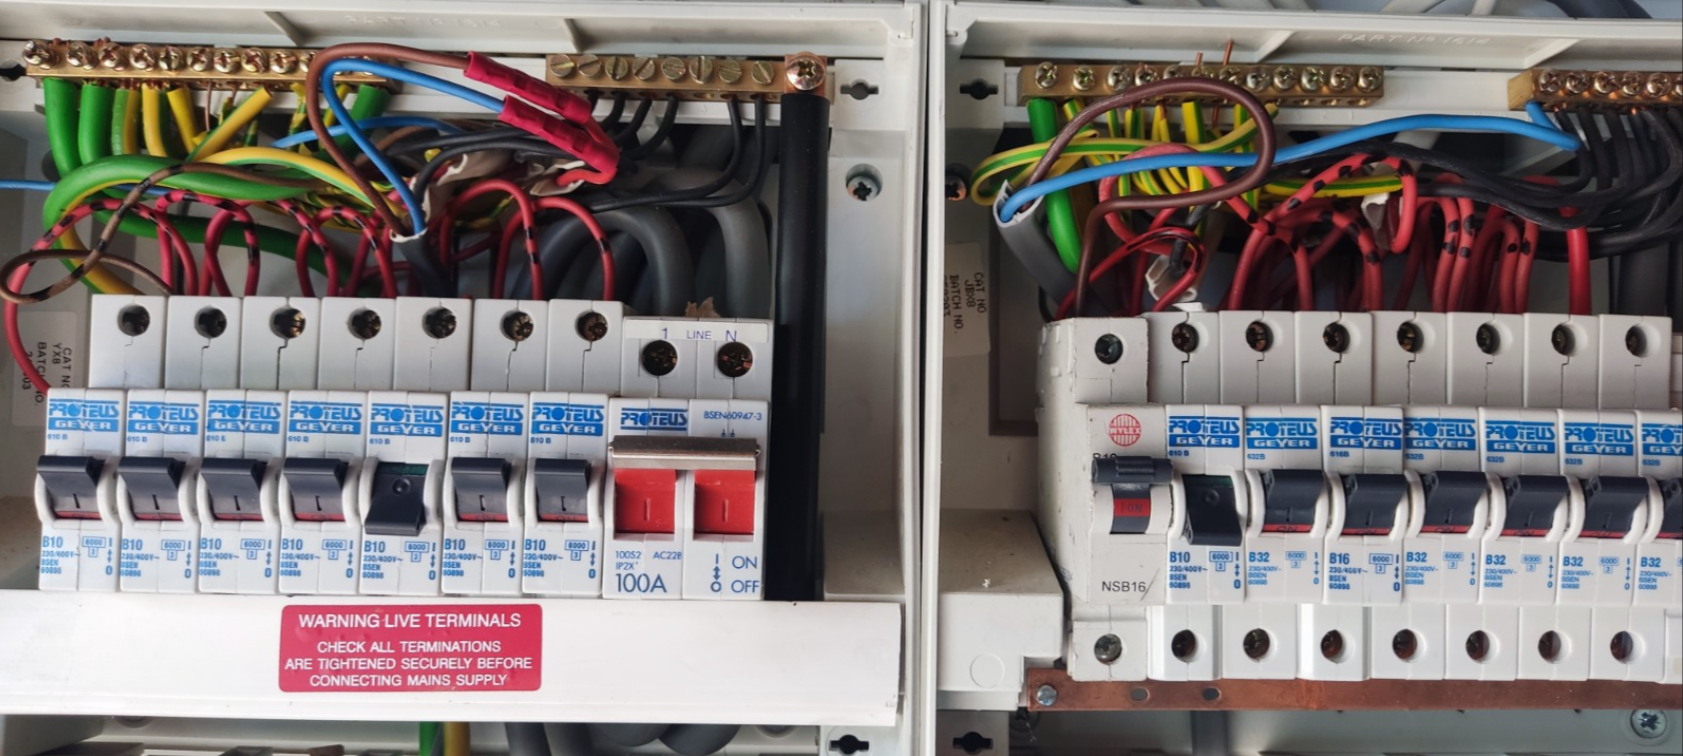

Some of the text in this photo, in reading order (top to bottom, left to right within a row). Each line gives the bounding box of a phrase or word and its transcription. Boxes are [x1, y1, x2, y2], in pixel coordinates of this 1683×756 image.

[974, 272, 985, 293] CAT
[950, 274, 962, 310] BATCH
[964, 280, 976, 308] JBX8
[662, 327, 737, 342] 1 LINE N
[52, 342, 62, 365] YX8
[62, 347, 72, 370] CAT
[37, 342, 47, 379] BATC
[621, 413, 687, 426] PROTEUS
[704, 411, 762, 420] BSEN60947-3
[56, 421, 112, 431] GEYER
[136, 422, 192, 432] GEYER
[215, 422, 272, 433] GEYER
[296, 423, 354, 432] GEYER
[378, 424, 435, 435] GEYER
[458, 422, 515, 432] GEYER
[539, 423, 596, 433] GEYER
[1109, 427, 1141, 435] WYLEX
[1177, 438, 1233, 446] GEYER
[1254, 440, 1309, 448] GEYER
[1338, 439, 1394, 448] GEYER
[1413, 440, 1468, 448] GEYER
[1494, 442, 1548, 451] GEYER
[1572, 444, 1626, 453] GEYER
[42, 536, 63, 549] B10
[122, 538, 142, 551] B10
[200, 538, 221, 550] B10
[282, 538, 303, 551] B10
[365, 541, 386, 553] B10
[445, 538, 466, 551] B10
[525, 538, 546, 551] B10
[616, 551, 641, 559] 100S2
[1170, 552, 1190, 563] B10
[1249, 552, 1270, 562] B32
[1330, 553, 1350, 564] B16
[1406, 552, 1427, 563] B32
[1486, 555, 1506, 565] B32
[732, 556, 758, 569] ON
[1563, 556, 1583, 567] B32
[1641, 557, 1661, 568] B32
[616, 573, 667, 593] 100A
[731, 580, 759, 593] OFF
[1102, 580, 1146, 592] NSB16
[299, 613, 521, 628] WARNING LIVE TERMINALS
[317, 641, 501, 653] CHECK ALL TERMINATIONS
[285, 658, 532, 670] ARE TIGHTENED SECURELY BEFORE
[310, 674, 507, 687] CONNECTING MAINS SUPPLY
